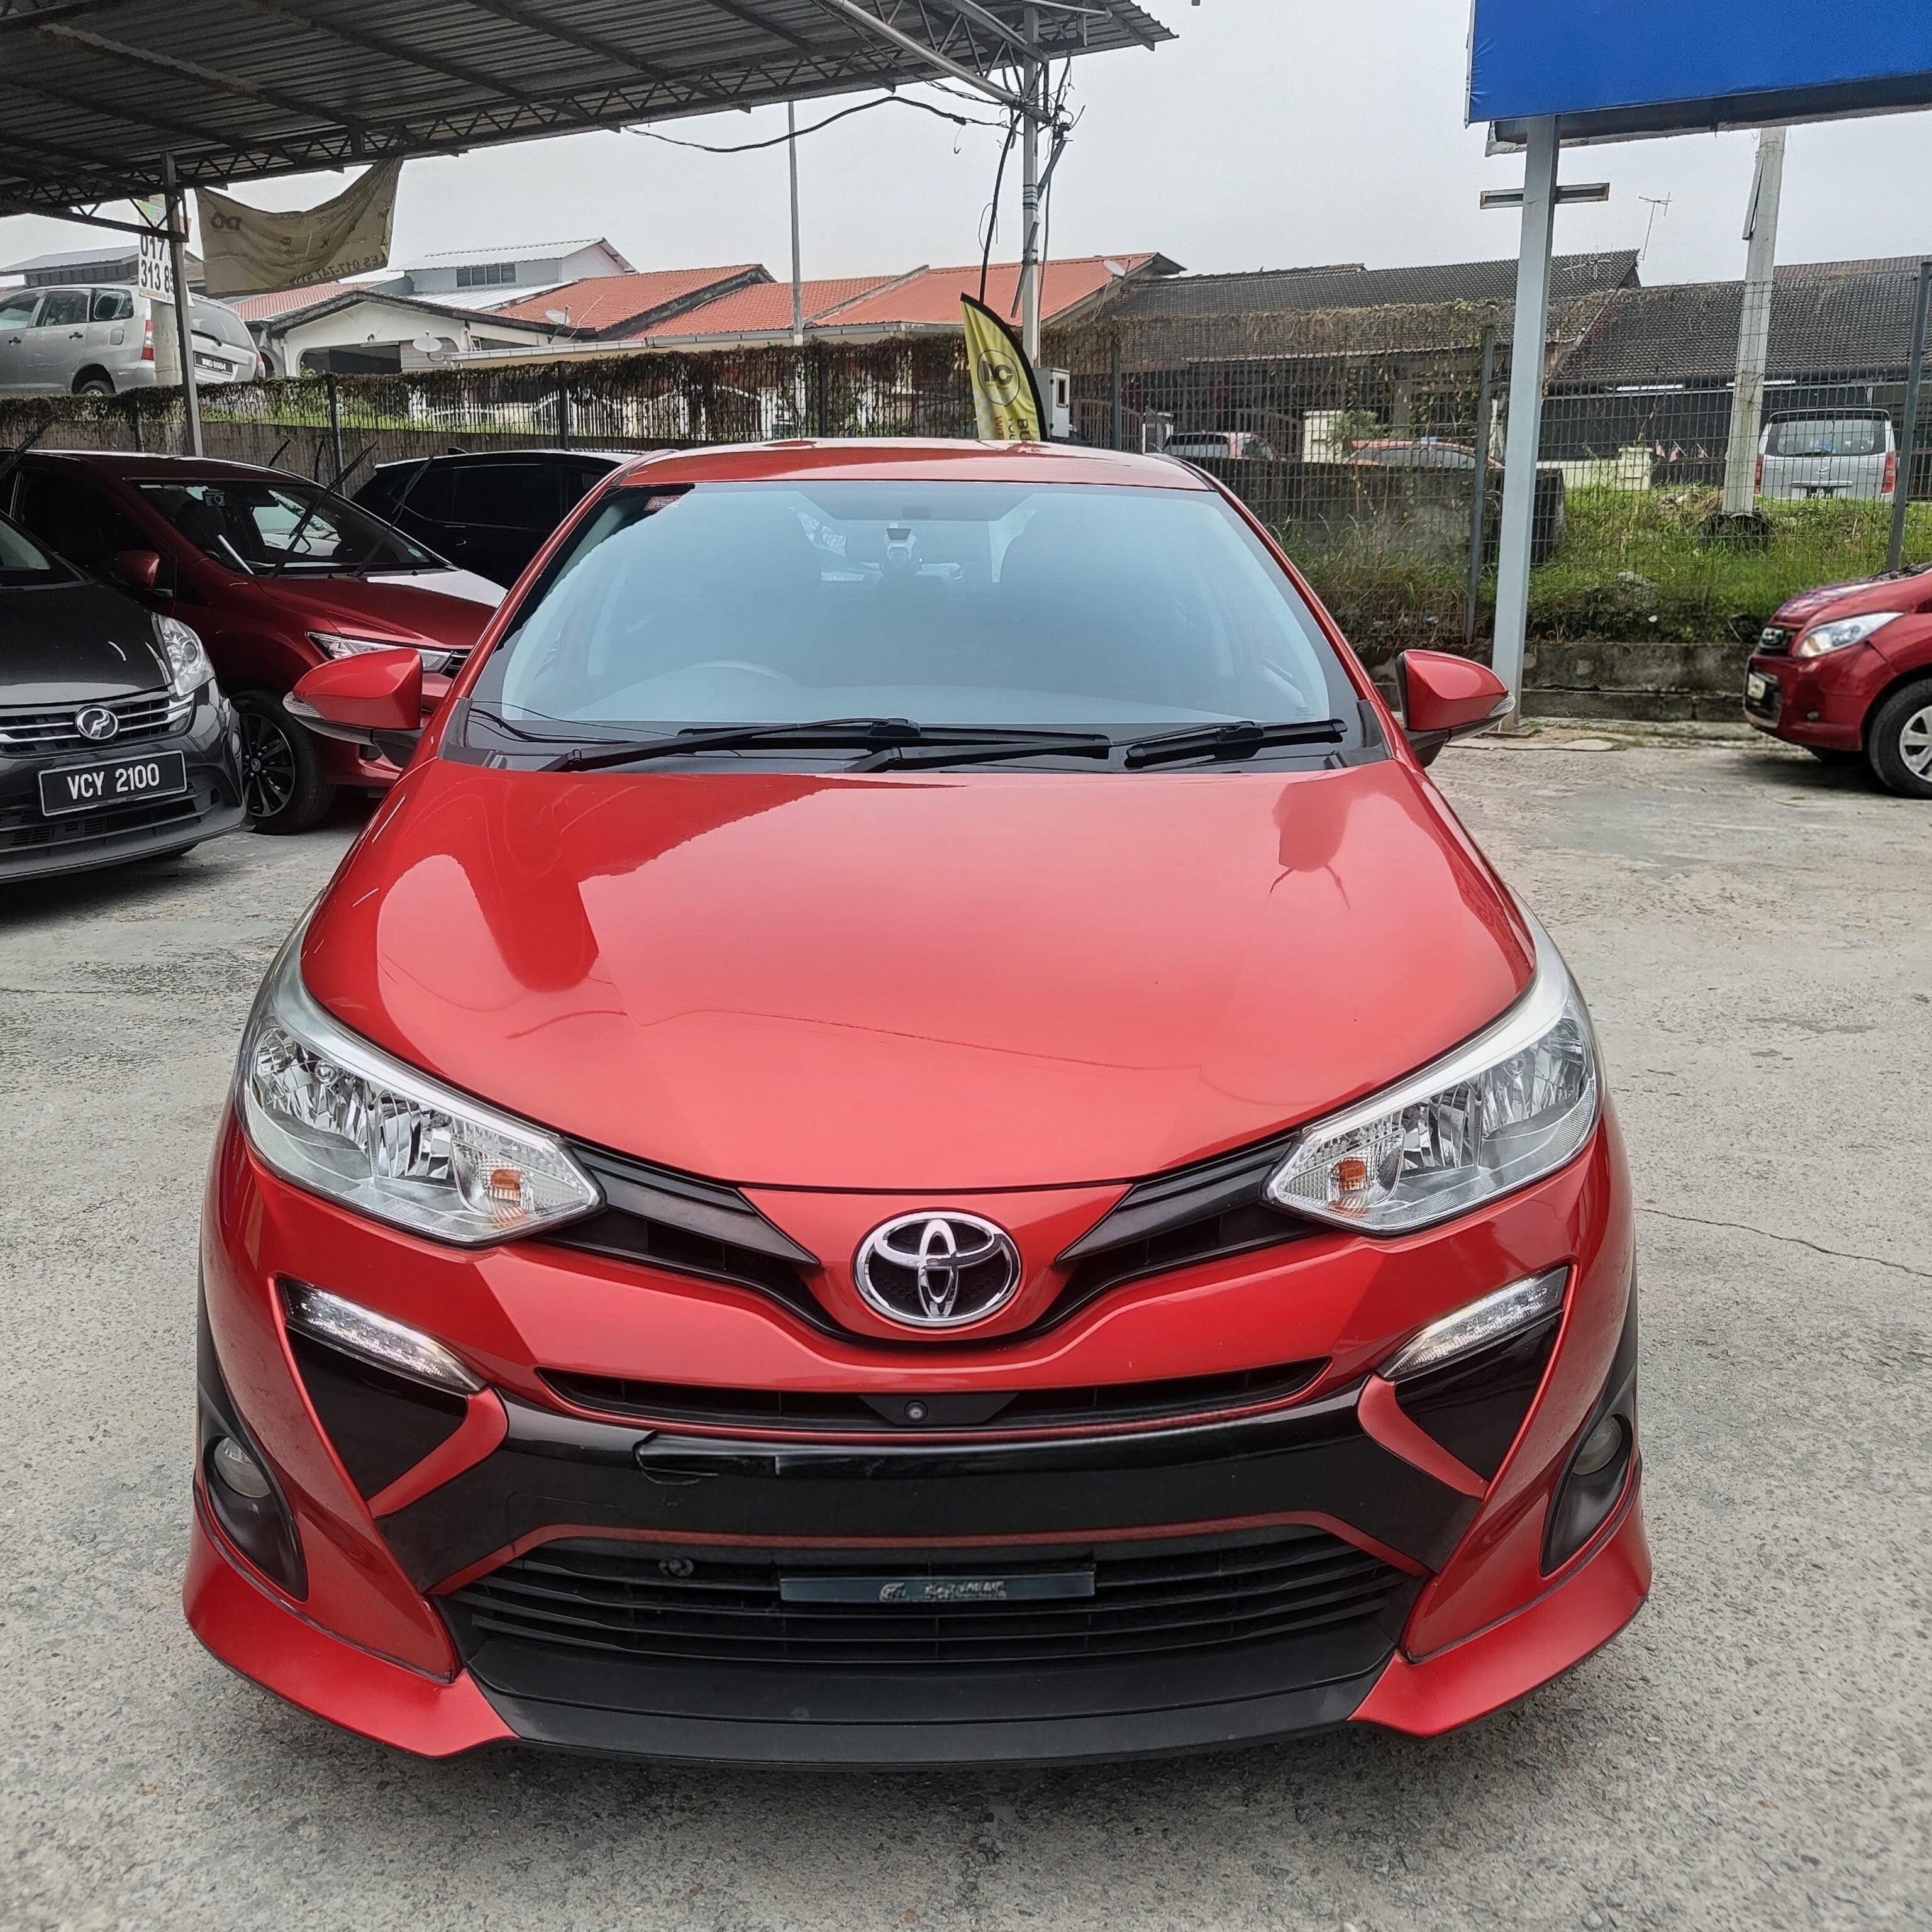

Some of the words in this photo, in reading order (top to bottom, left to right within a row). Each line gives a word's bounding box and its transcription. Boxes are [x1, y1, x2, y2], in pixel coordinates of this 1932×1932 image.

[140, 234, 165, 261] 017
[141, 259, 161, 291] 313
[66, 771, 105, 800] VCY
[114, 762, 160, 792] 2100
